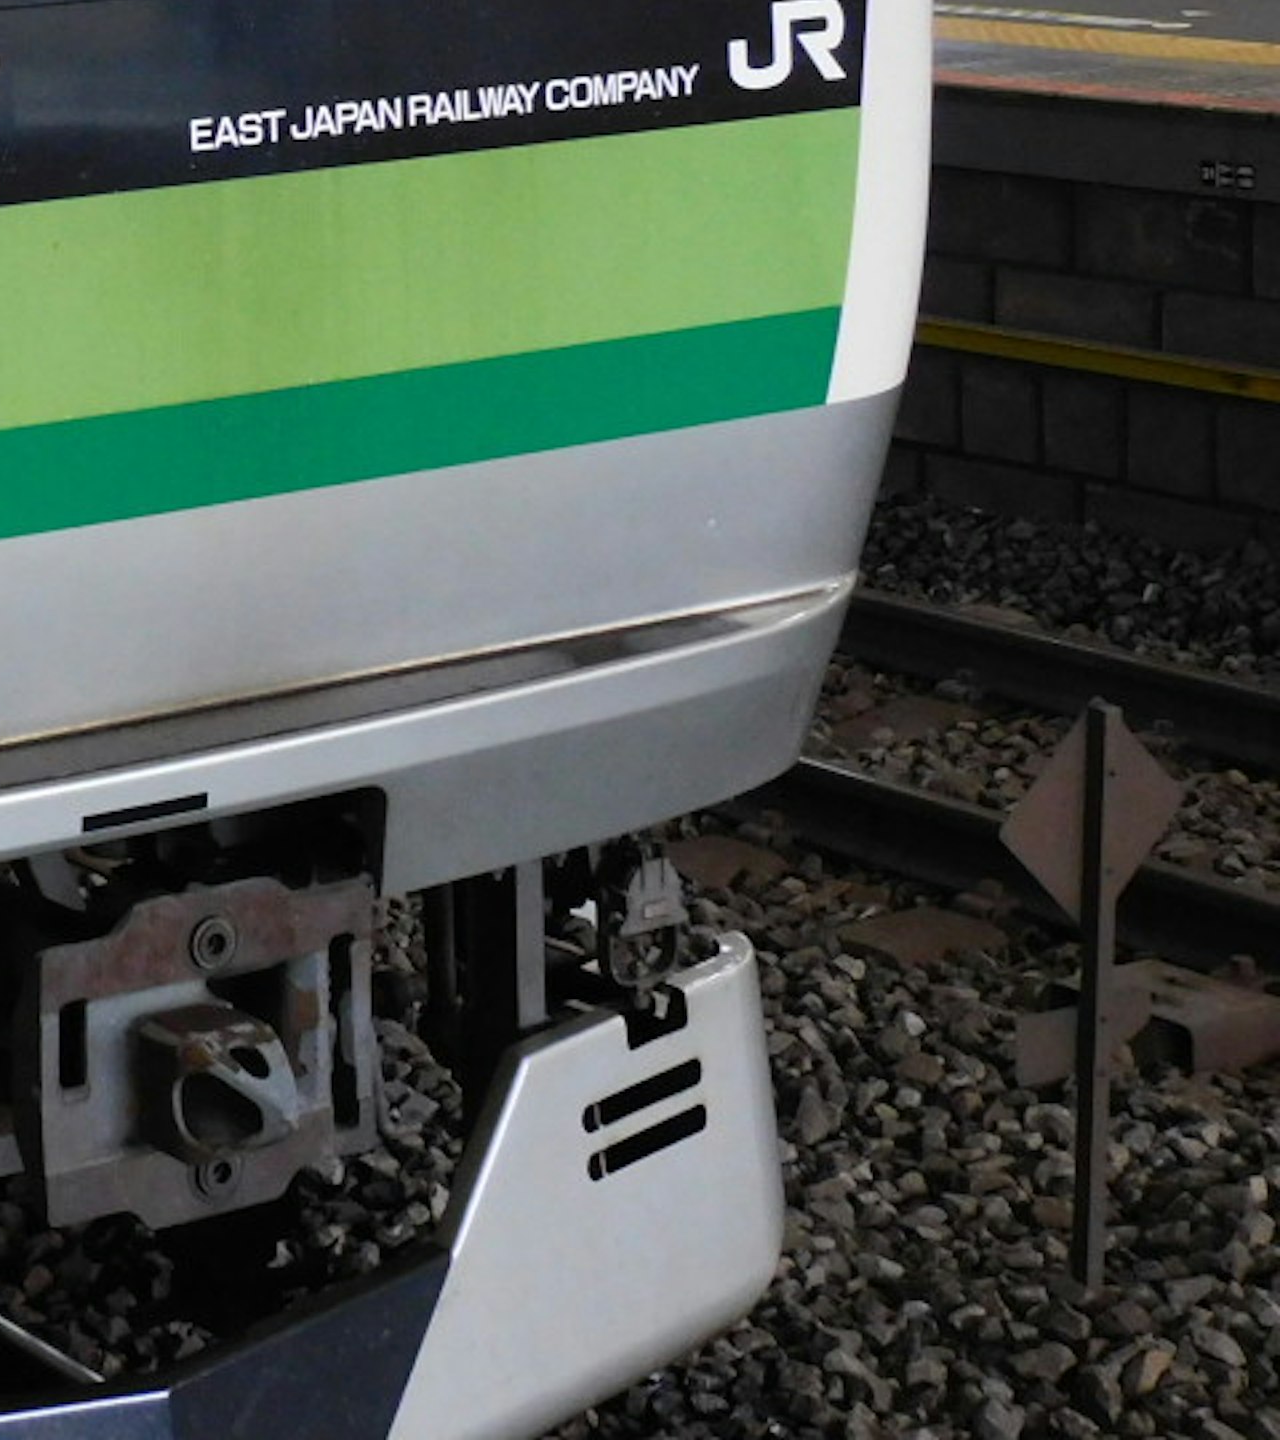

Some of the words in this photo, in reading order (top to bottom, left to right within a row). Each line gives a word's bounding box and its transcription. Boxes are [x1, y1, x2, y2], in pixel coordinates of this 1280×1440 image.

[190, 107, 286, 152] EAST
[290, 96, 405, 141] JAPAN
[407, 81, 542, 126] RAILWAY
[544, 64, 701, 111] COMPANY
